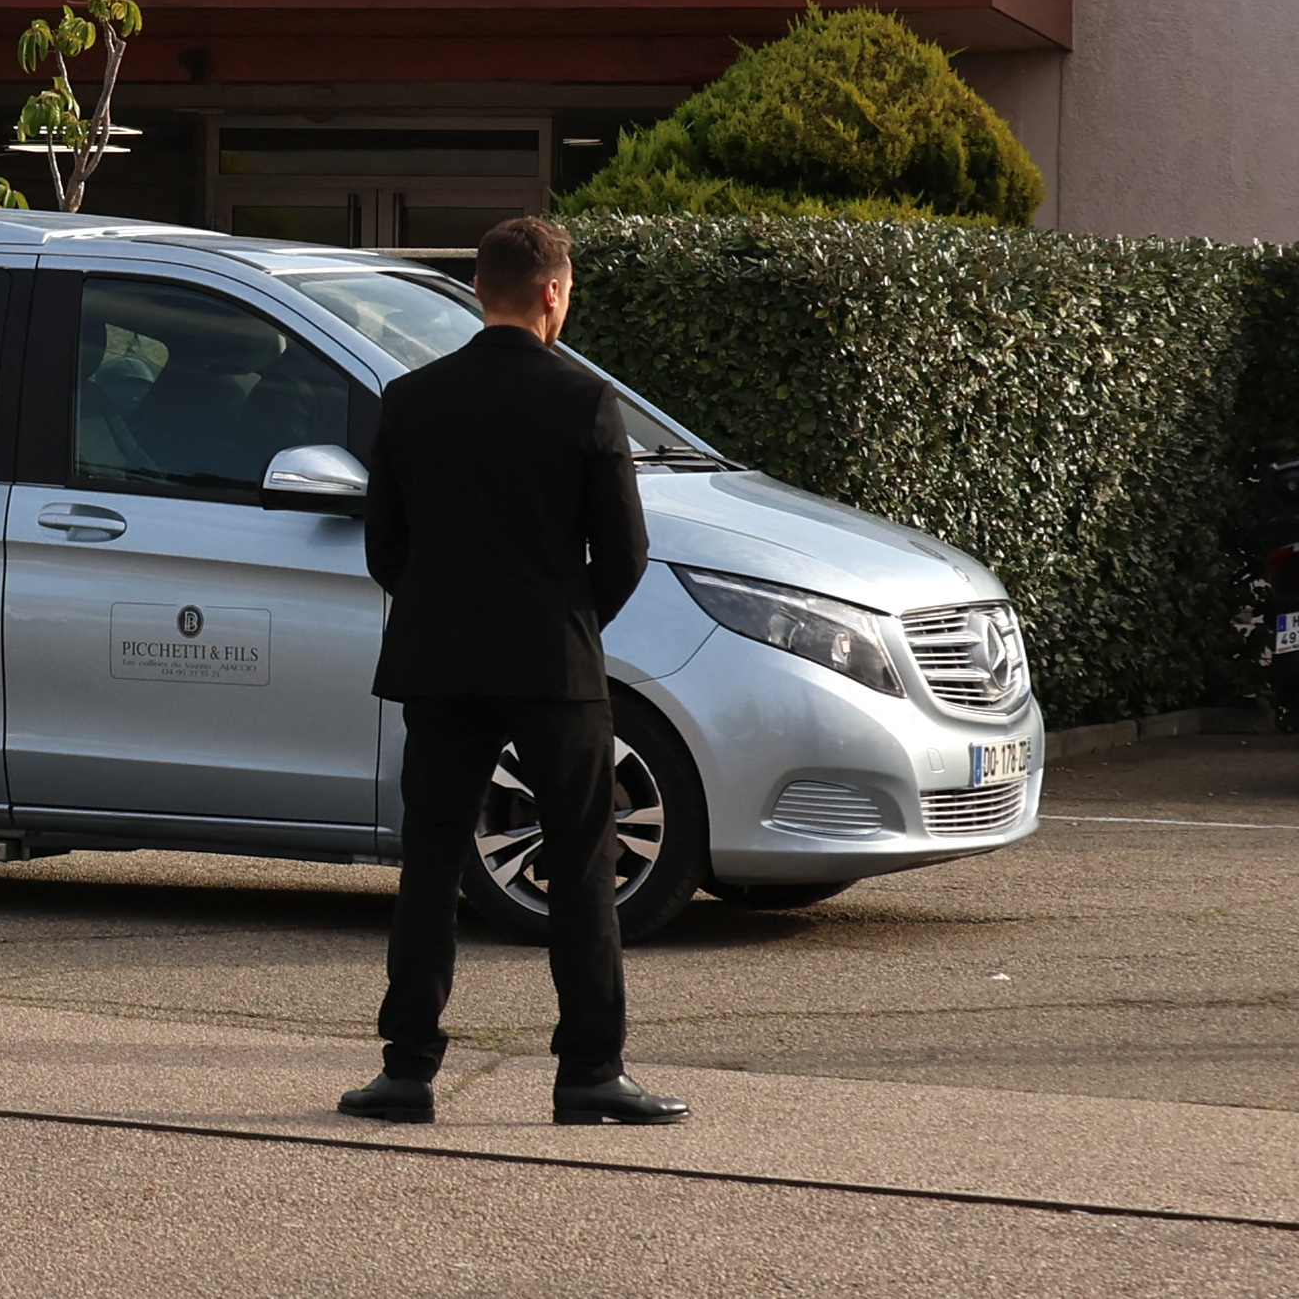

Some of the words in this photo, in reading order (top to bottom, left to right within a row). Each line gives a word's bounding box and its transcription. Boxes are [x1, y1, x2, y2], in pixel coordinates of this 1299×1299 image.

[1281, 631, 1299, 645] 49
[122, 641, 207, 660] PICCHETTI
[209, 645, 221, 661] &
[225, 646, 259, 662] FILS
